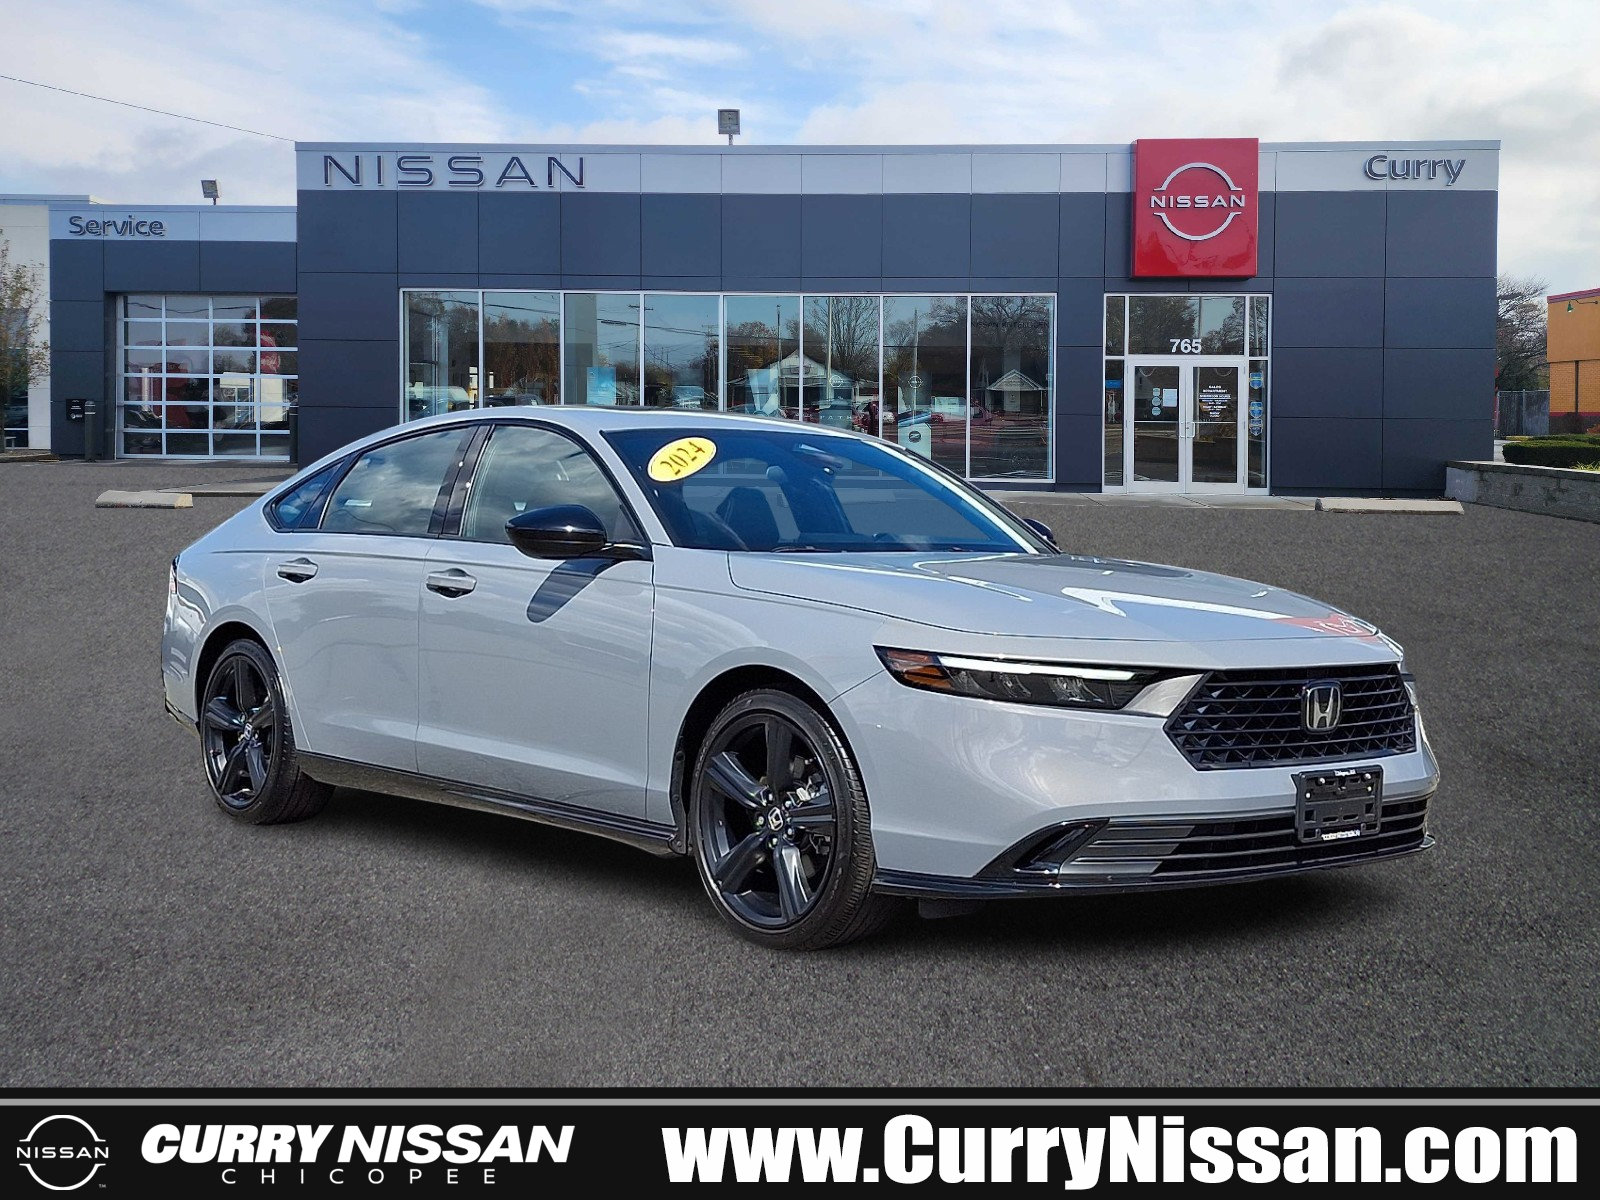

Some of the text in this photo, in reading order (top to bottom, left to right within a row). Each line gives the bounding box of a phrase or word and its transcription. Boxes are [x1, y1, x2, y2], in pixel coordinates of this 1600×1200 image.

[323, 155, 585, 188] NISSAN
[1365, 155, 1467, 187] Curry
[1149, 194, 1246, 208] NISSAN
[69, 214, 166, 237] Service
[1169, 338, 1202, 353] 765
[660, 442, 706, 476] 2024
